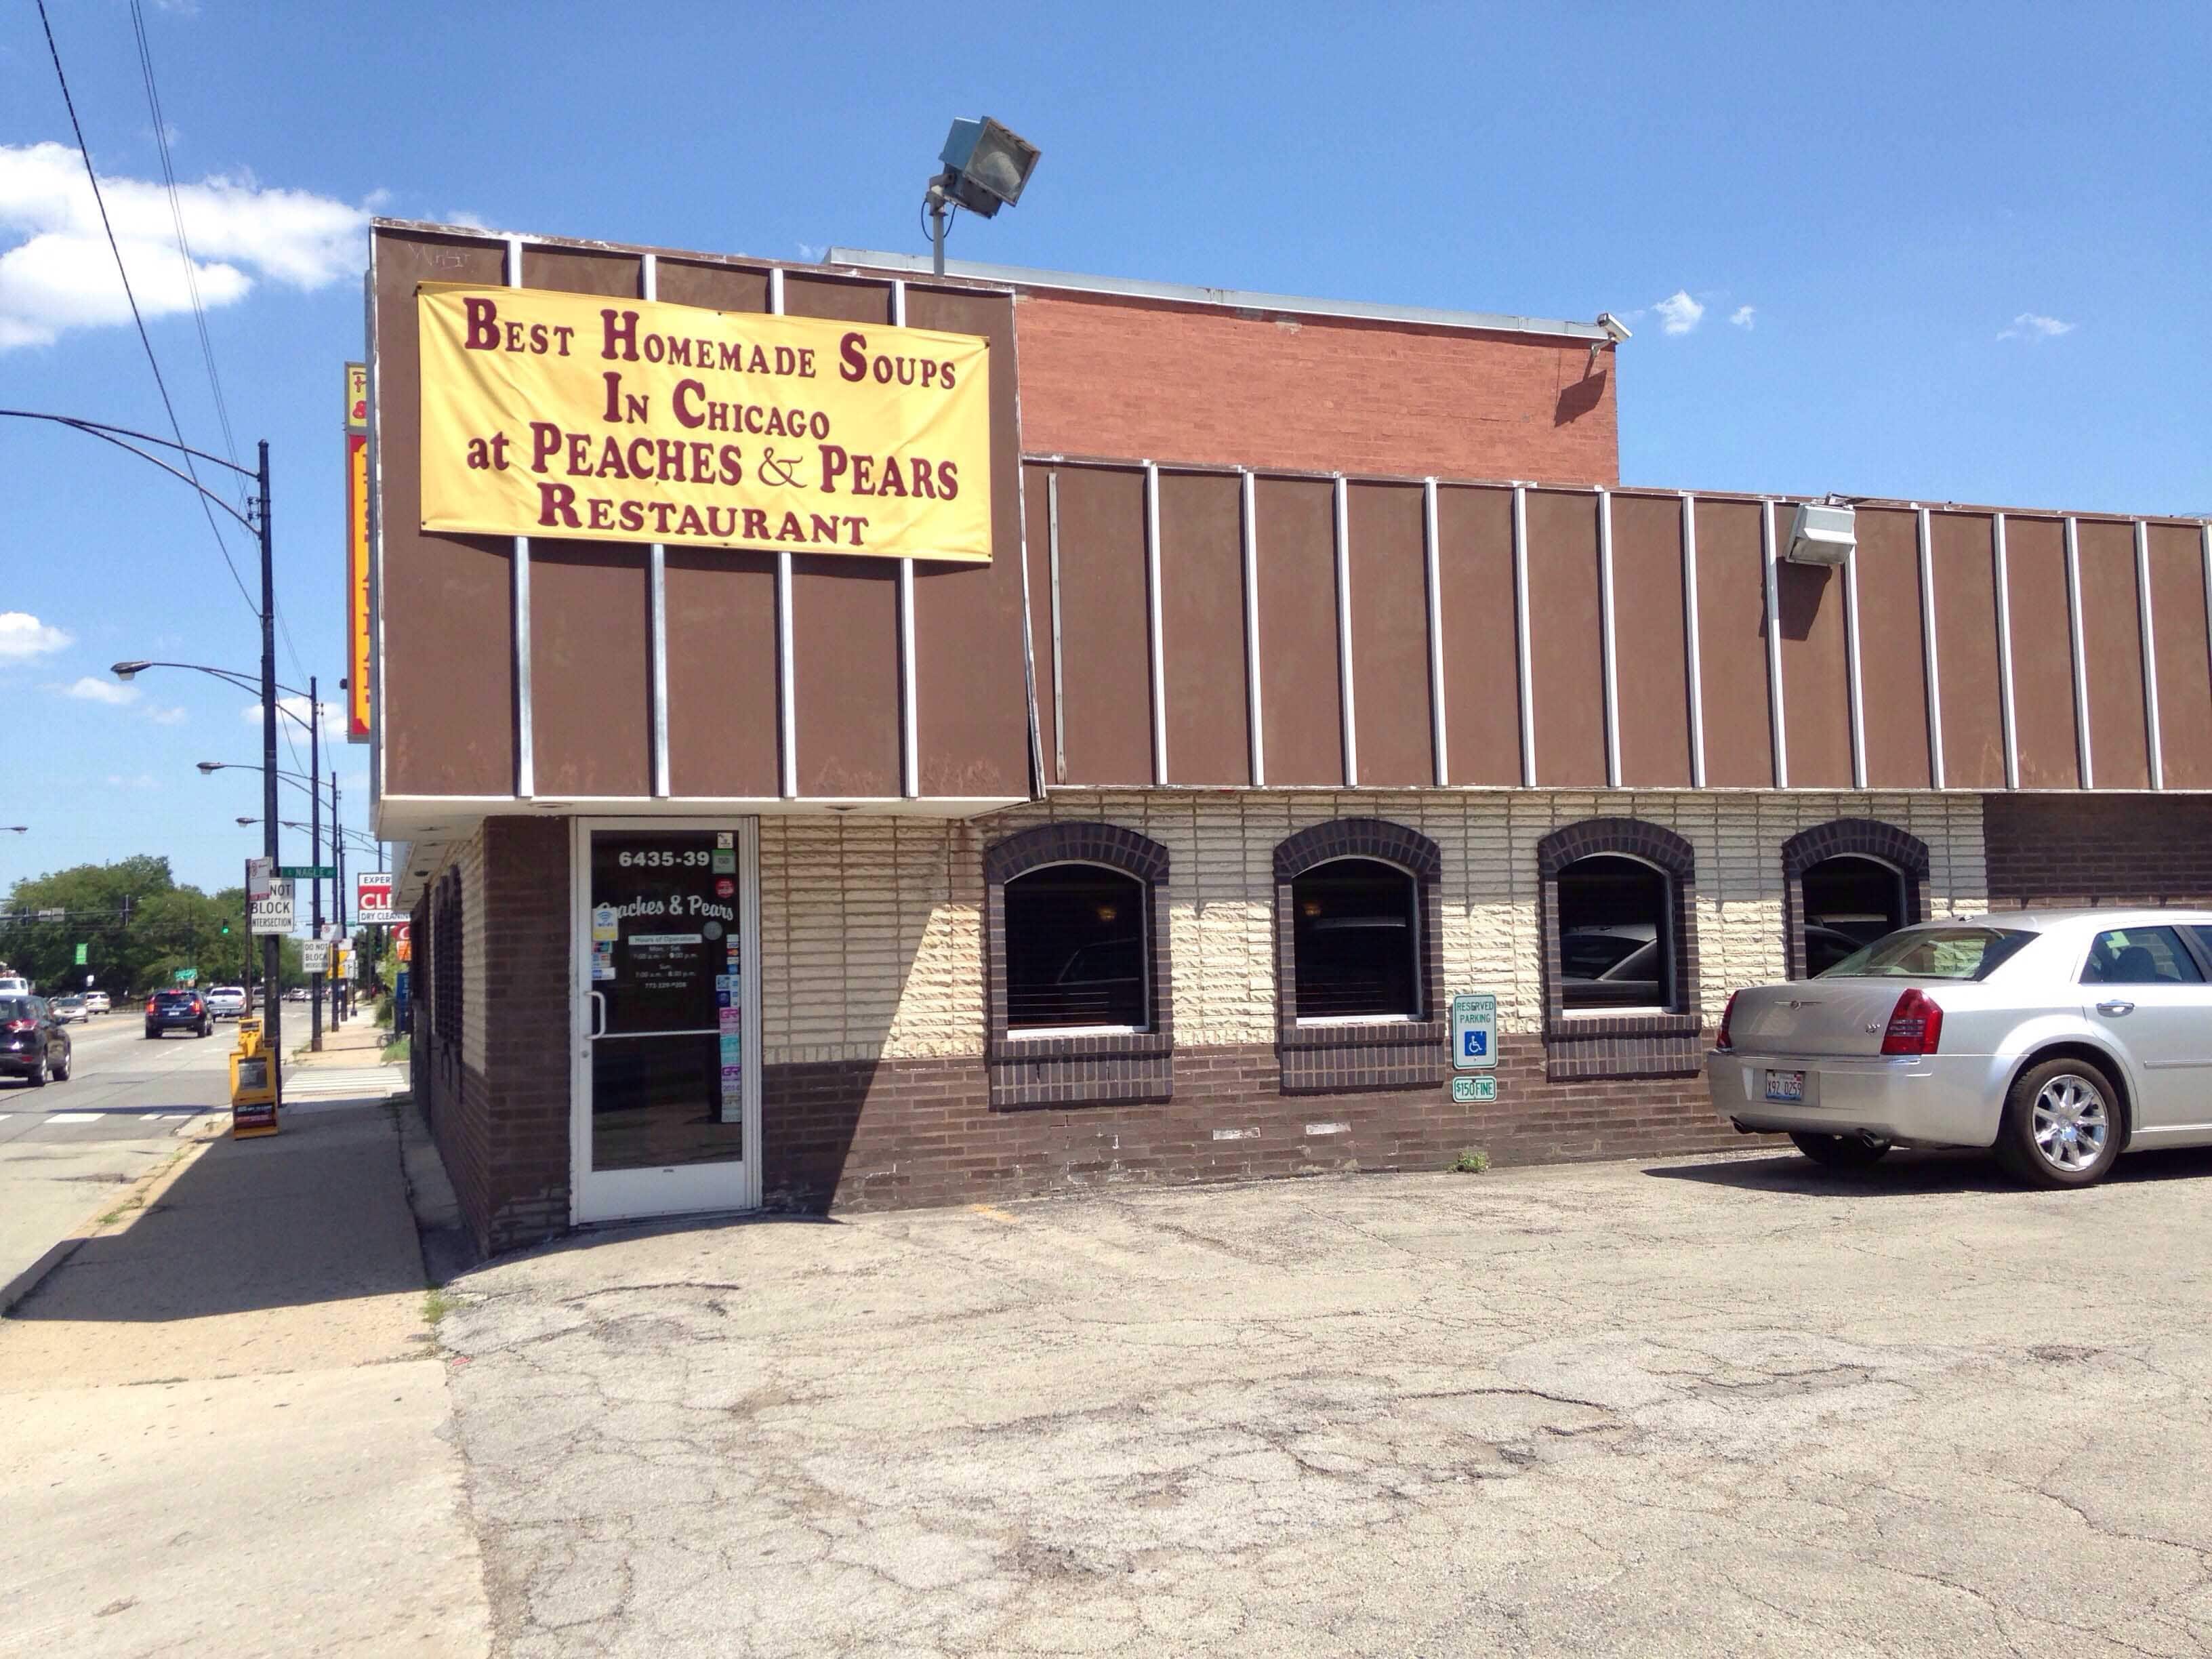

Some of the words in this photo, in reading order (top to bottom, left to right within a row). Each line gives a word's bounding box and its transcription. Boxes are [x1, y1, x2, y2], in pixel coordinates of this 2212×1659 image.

[463, 297, 574, 356] BEST
[600, 308, 817, 378] HOMEMADE
[840, 332, 956, 390] SOUPS
[602, 371, 650, 424] IN
[672, 378, 830, 441] CHICAGO
[467, 432, 510, 471] at
[530, 422, 743, 487] PEACHES
[758, 447, 808, 489] &
[818, 444, 959, 501] PEARS
[537, 482, 869, 546] RESTAURANT
[618, 851, 710, 867] 6435-39
[270, 884, 291, 897] NOT
[251, 901, 290, 914] BLOCK
[596, 895, 665, 920] aches
[669, 895, 683, 916] &
[687, 895, 734, 921] Pears
[251, 916, 292, 927] NTERSECTION
[361, 912, 375, 920] DRY
[1457, 1001, 1494, 1011] RESERVED
[1460, 1014, 1491, 1023] PARKING
[1456, 1082, 1475, 1096] $150
[1475, 1082, 1493, 1096] FINE
[1767, 1079, 1781, 1095] X92
[1784, 1080, 1801, 1096] 0259
